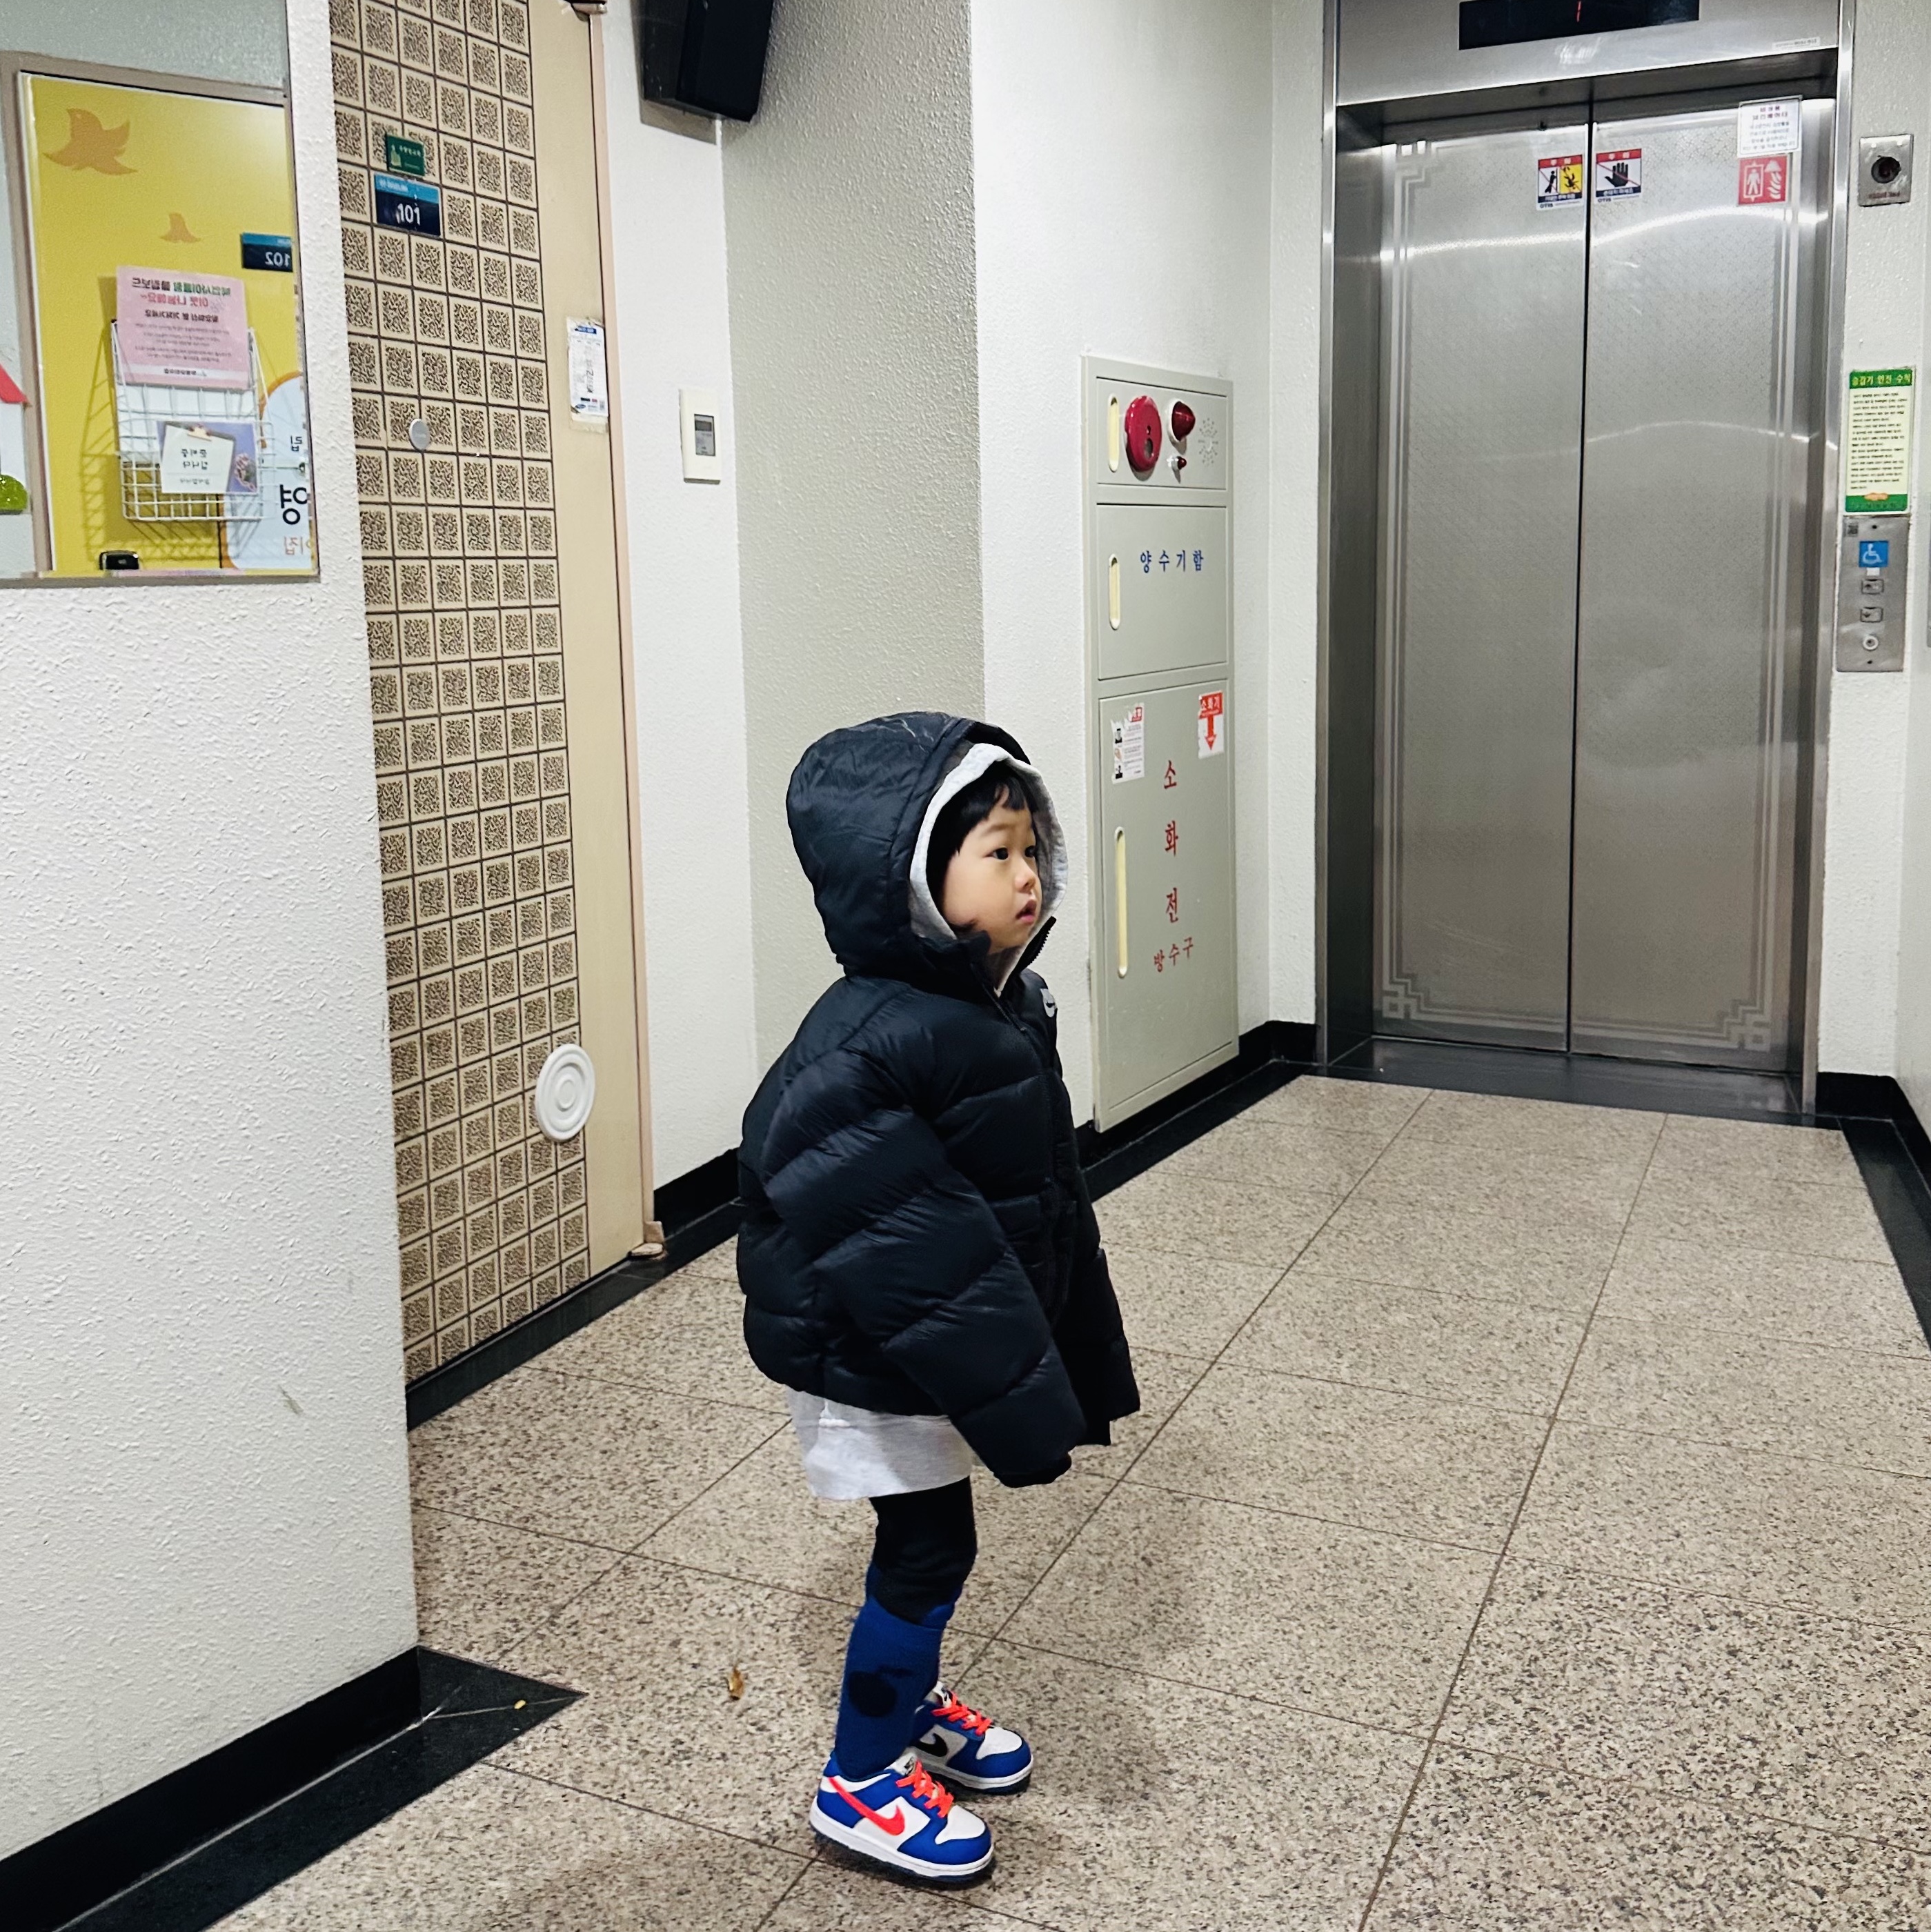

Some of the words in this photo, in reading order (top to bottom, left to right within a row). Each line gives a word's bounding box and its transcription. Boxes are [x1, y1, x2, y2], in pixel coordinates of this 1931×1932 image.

[397, 203, 421, 226] 101
[1140, 550, 1204, 573] 양수기함
[1153, 937, 1194, 973] 방수구
